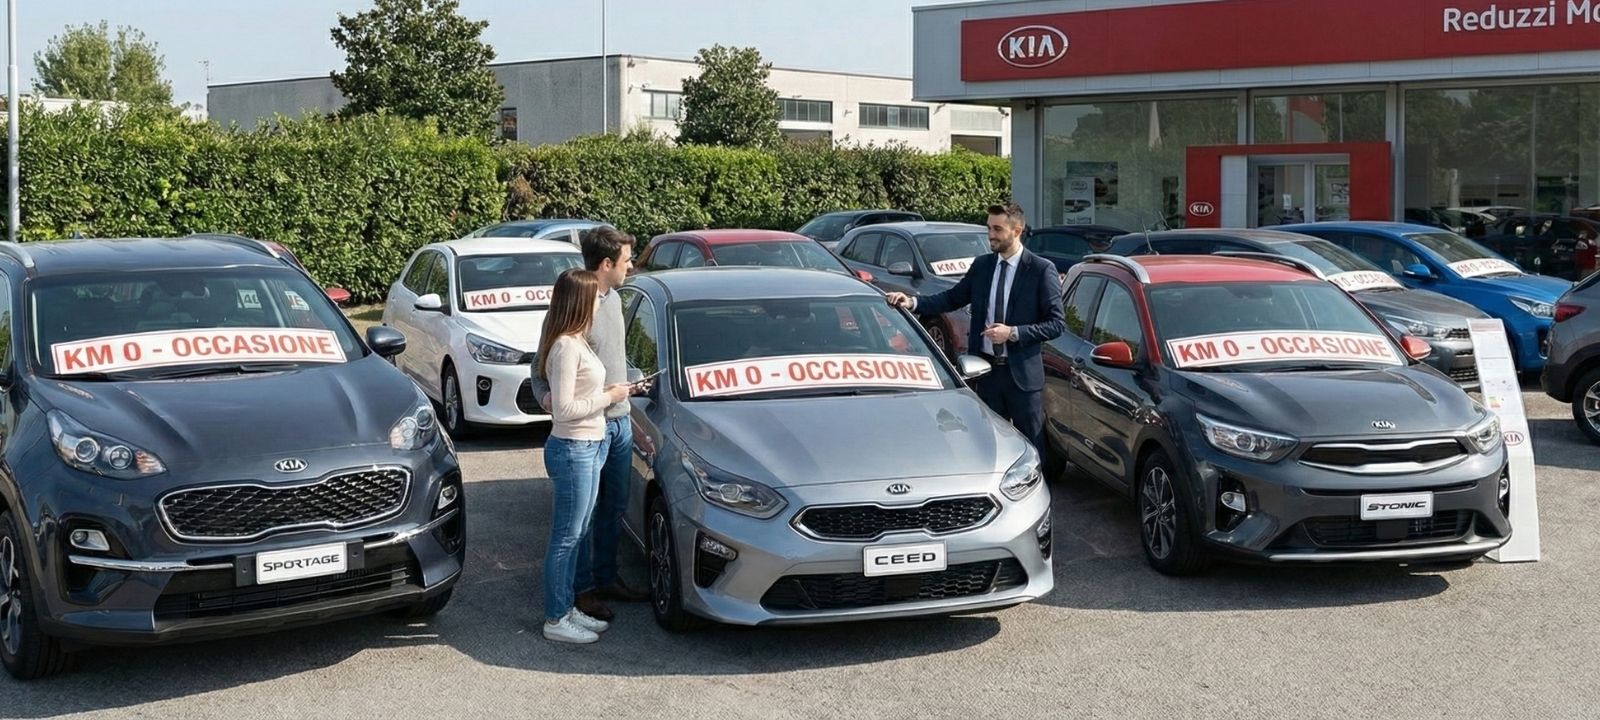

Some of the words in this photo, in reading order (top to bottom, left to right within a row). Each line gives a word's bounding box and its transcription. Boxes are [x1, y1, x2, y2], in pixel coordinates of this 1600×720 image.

[1443, 1, 1556, 32] Reduzzi
[1008, 34, 1056, 59] KIA
[936, 262, 957, 272] KM
[470, 292, 497, 307] KM
[64, 344, 114, 370] KM
[123, 341, 142, 362] 0
[172, 334, 336, 358] OCCASIONE
[1177, 341, 1219, 362] KM
[1223, 339, 1240, 358] 0
[1260, 336, 1392, 358] OCCASIONE
[695, 369, 738, 392] KM
[745, 365, 762, 385] 0
[788, 360, 933, 382] OCCASIONE
[888, 484, 912, 494] KIA
[1367, 501, 1427, 511] STONIC
[263, 554, 340, 572] SPORTAGE
[875, 552, 936, 566] CEED
